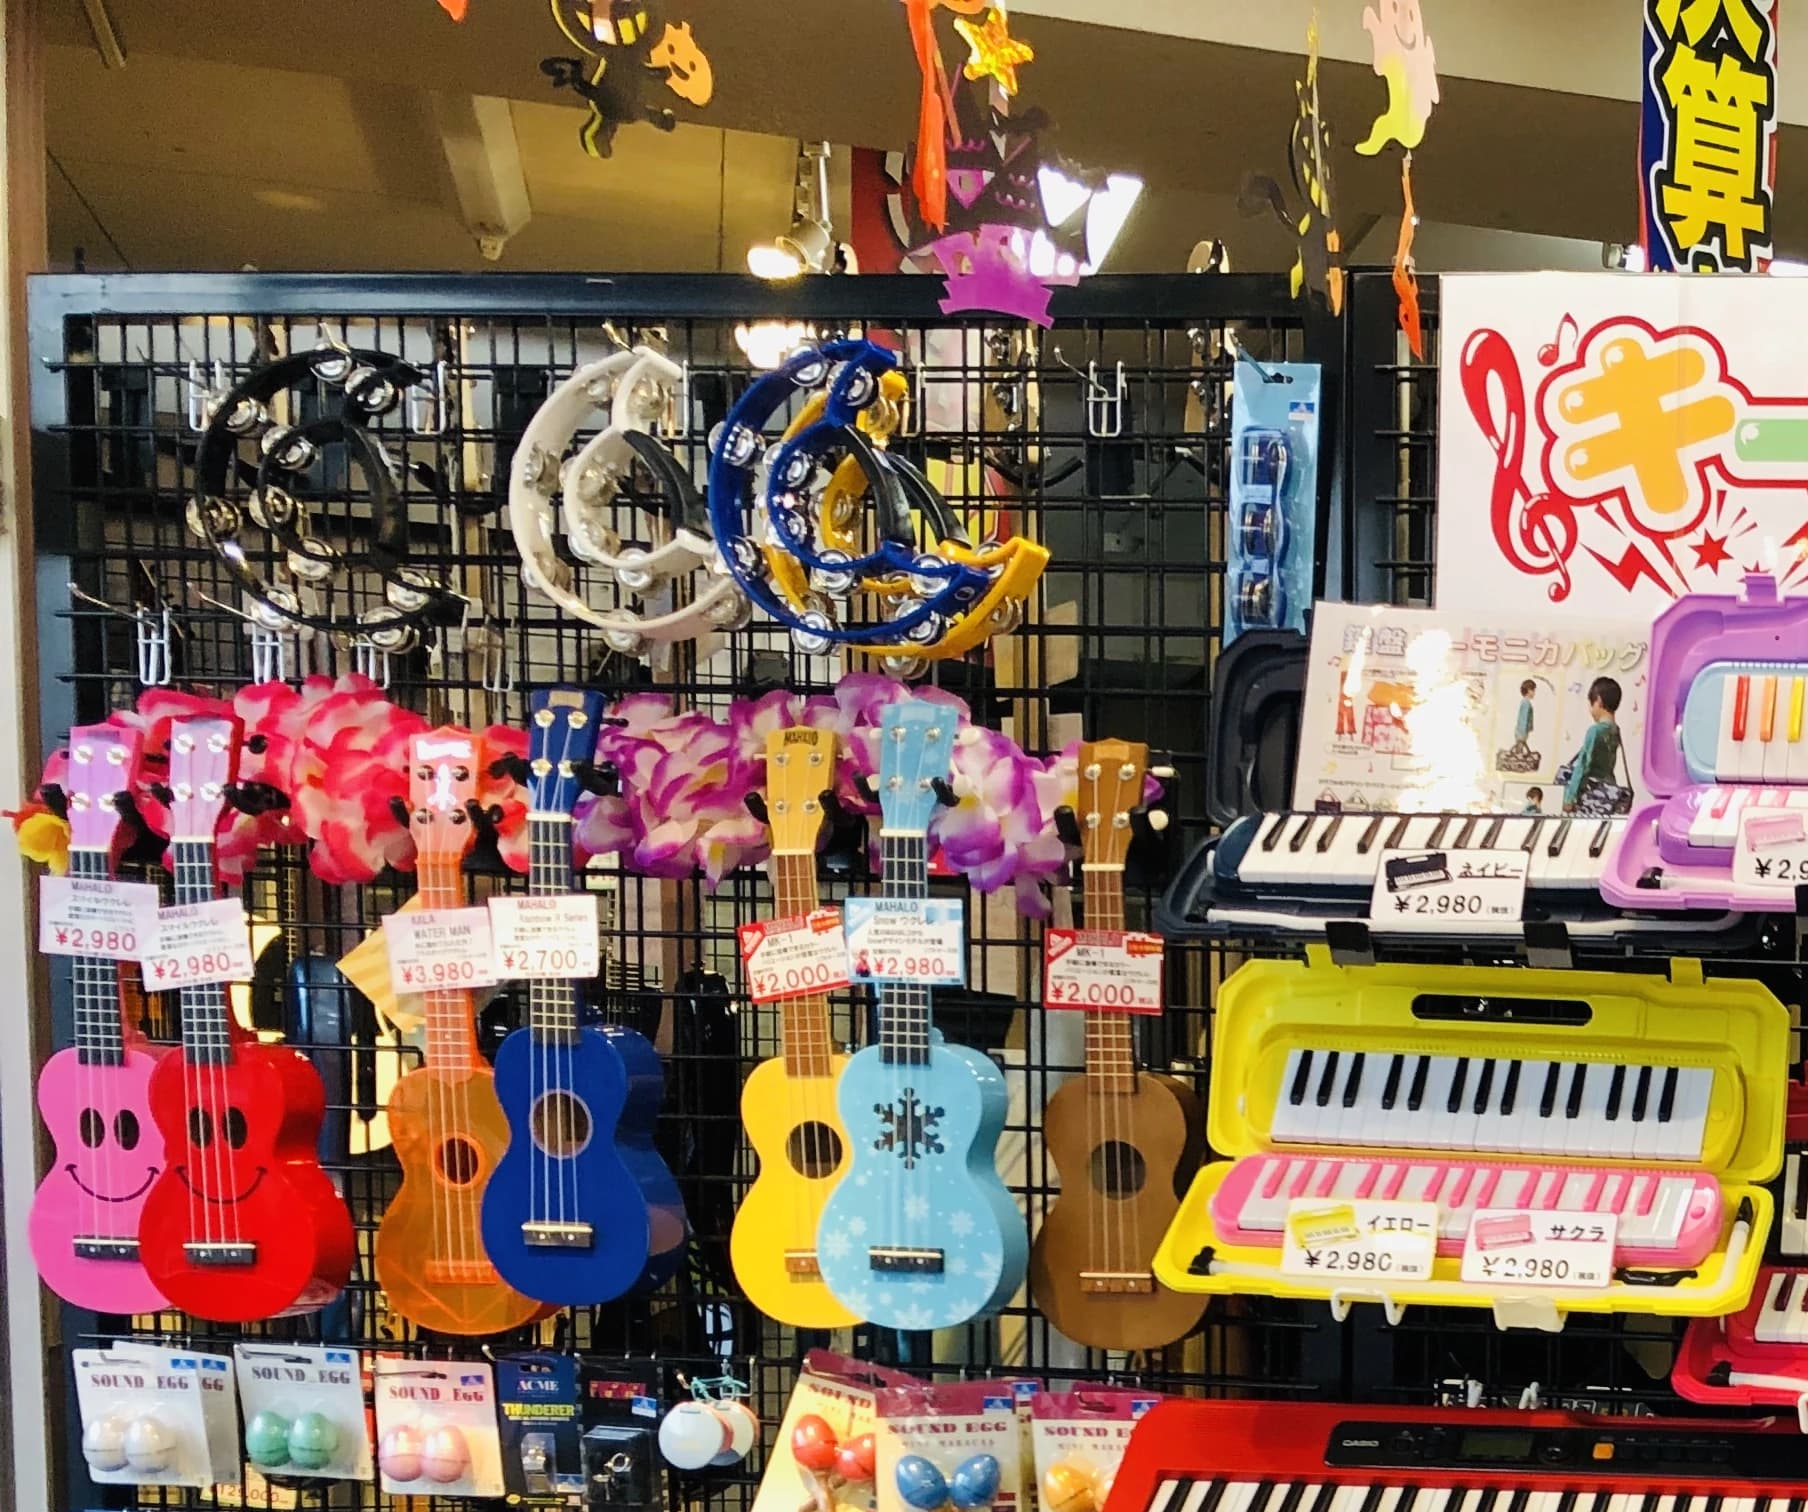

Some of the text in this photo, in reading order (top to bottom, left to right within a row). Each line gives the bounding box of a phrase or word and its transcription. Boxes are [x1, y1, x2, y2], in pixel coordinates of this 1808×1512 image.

[1458, 863, 1523, 879] ネイビー
[1393, 894, 1483, 916] ¥2,980
[55, 927, 137, 952] ¥2,980
[152, 951, 231, 980] ¥2,980
[503, 949, 578, 971] ¥2,700
[873, 956, 945, 976] ¥2,980
[402, 961, 474, 984] ¥3,980
[753, 963, 831, 995] ¥2,000
[1052, 981, 1136, 1005] ¥2,000
[1367, 1215, 1431, 1232] イエロー
[1549, 1224, 1606, 1240] サクラ
[1304, 1249, 1392, 1272] ¥2,980
[91, 1373, 190, 1390] SOUND EGG
[251, 1367, 352, 1385] SOUND EGG
[516, 1378, 560, 1392] ACME
[388, 1386, 485, 1403] SOUND EGG
[964, 1420, 1008, 1433] EGG
[1043, 1426, 1109, 1438] SOUND
